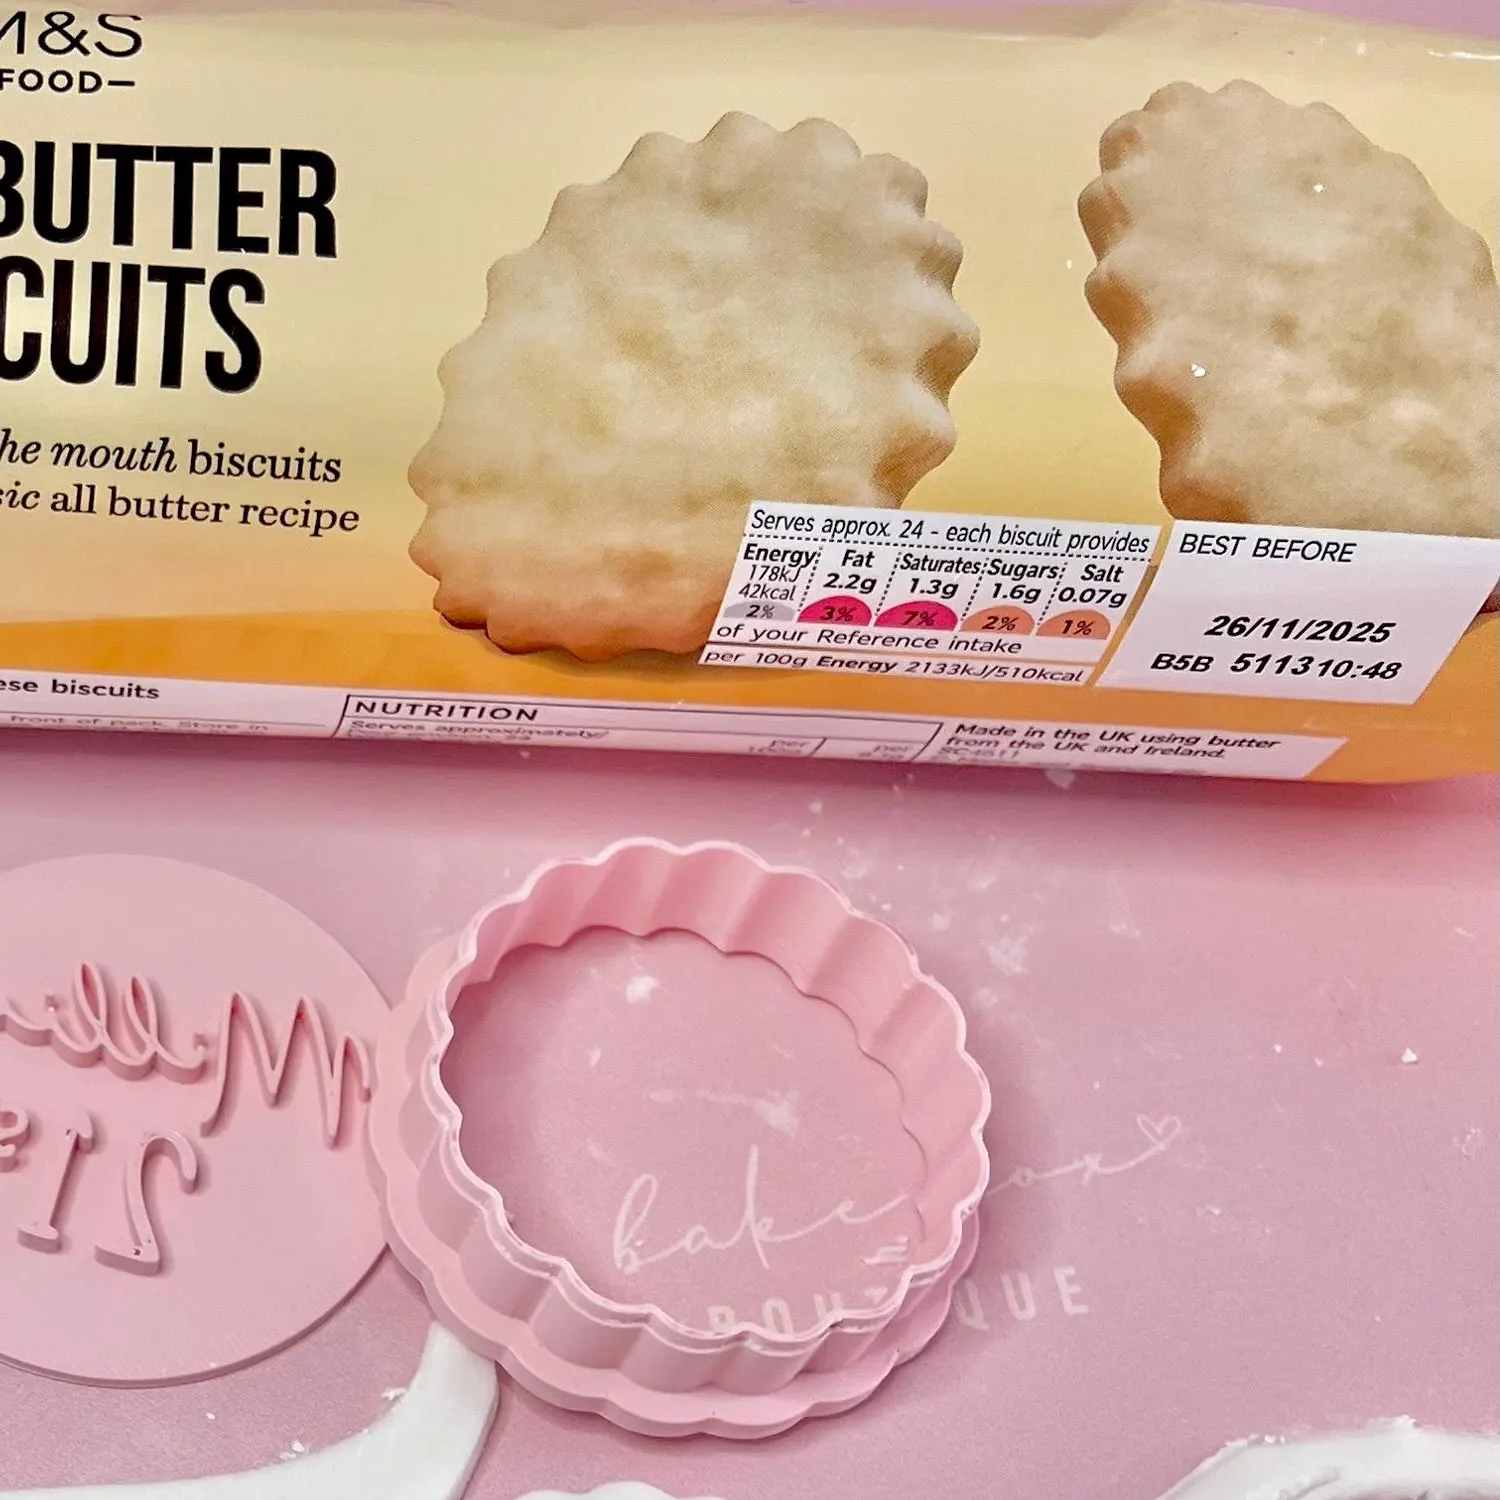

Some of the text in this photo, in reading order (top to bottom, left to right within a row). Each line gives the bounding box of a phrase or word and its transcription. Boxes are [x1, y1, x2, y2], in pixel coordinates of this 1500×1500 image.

[50, 435, 178, 474] mouth
[187, 438, 342, 483] biscuits
[50, 484, 97, 515] all
[108, 486, 232, 525] butter
[238, 498, 361, 538] recipe
[752, 509, 815, 532] Serves
[821, 517, 891, 539] approx.
[899, 519, 925, 540] 24
[946, 522, 991, 545] each
[999, 524, 1063, 548] biscuit
[1066, 531, 1150, 553] provides
[743, 543, 818, 569] Energy
[841, 549, 875, 568] Fat
[1178, 533, 1357, 563] BEST BEFORE
[749, 564, 801, 583] 178kJ
[900, 553, 982, 575] Saturates
[987, 558, 1059, 581] Sugars
[1080, 563, 1124, 584] Salt
[738, 583, 797, 601] 42kcal
[823, 573, 877, 594] 2.2g
[909, 578, 959, 600] 1.3g
[991, 583, 1042, 604] 1.6g
[1058, 586, 1128, 609] 0.07g
[746, 604, 774, 619] 2%
[819, 605, 857, 622] 3%
[902, 610, 937, 627] 7%
[981, 615, 1019, 632] 2%
[1061, 619, 1095, 636] 1%
[1204, 615, 1396, 644] 26/11/2025
[717, 624, 1022, 654] of your Reference intake
[704, 651, 1084, 682] per 100g Energy 2133kJ/510kcal
[1150, 653, 1214, 672] B5B
[52, 678, 160, 699] biscuits
[355, 701, 538, 721] NUTRITION
[946, 736, 1003, 749] from
[1009, 737, 1045, 750] the
[1053, 741, 1090, 752] UK
[1093, 744, 1138, 755] and
[955, 724, 1281, 750] Made in the UK using butter
